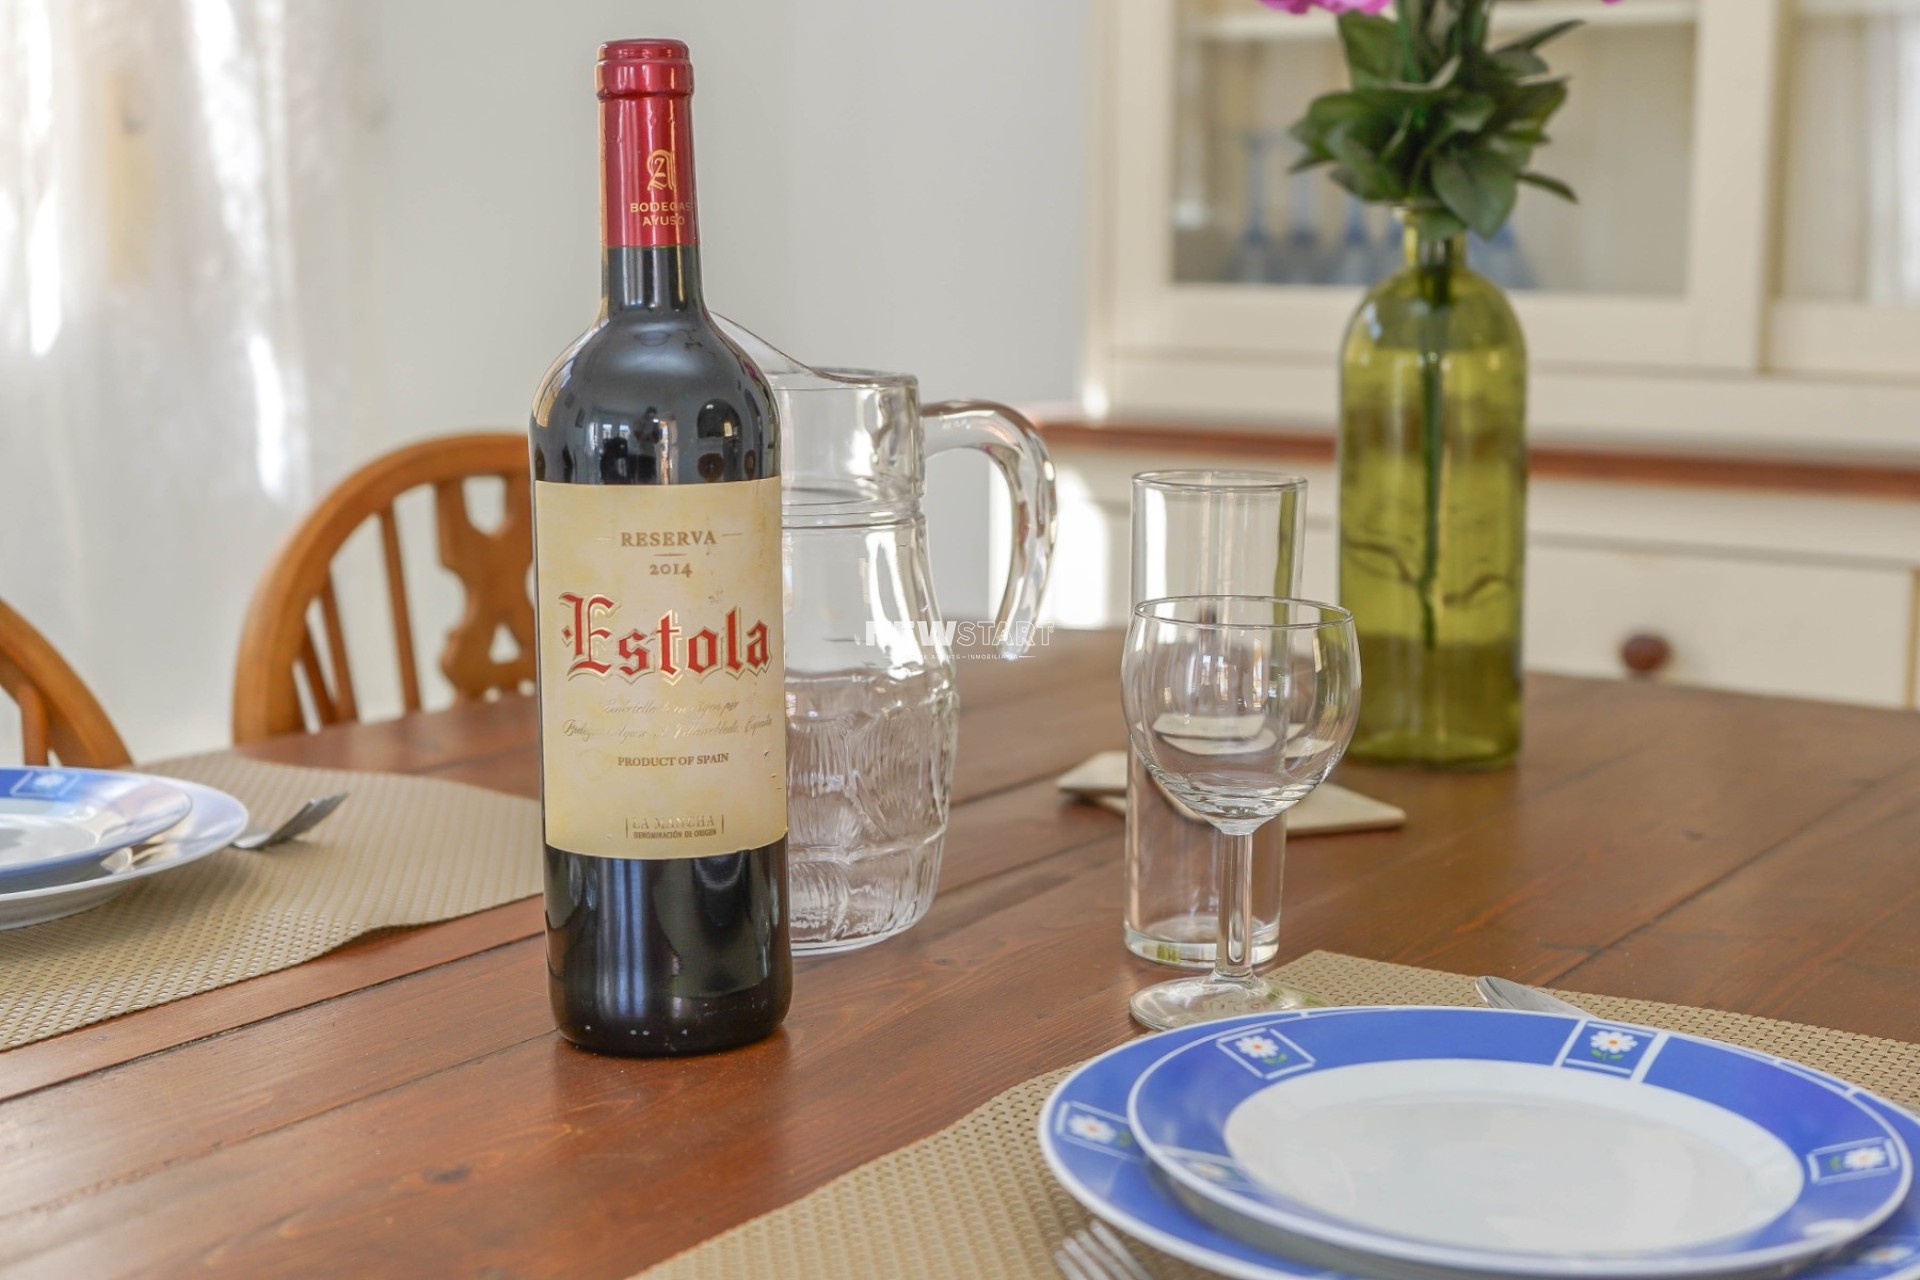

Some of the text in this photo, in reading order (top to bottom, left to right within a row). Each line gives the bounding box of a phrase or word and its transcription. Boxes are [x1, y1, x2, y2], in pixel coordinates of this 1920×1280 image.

[642, 215, 686, 226] AYUSO
[621, 531, 717, 547] RESERVA
[649, 562, 693, 578] 2014
[559, 592, 770, 685] Estola
[617, 752, 730, 767] PRODUCT OF SPAIN
